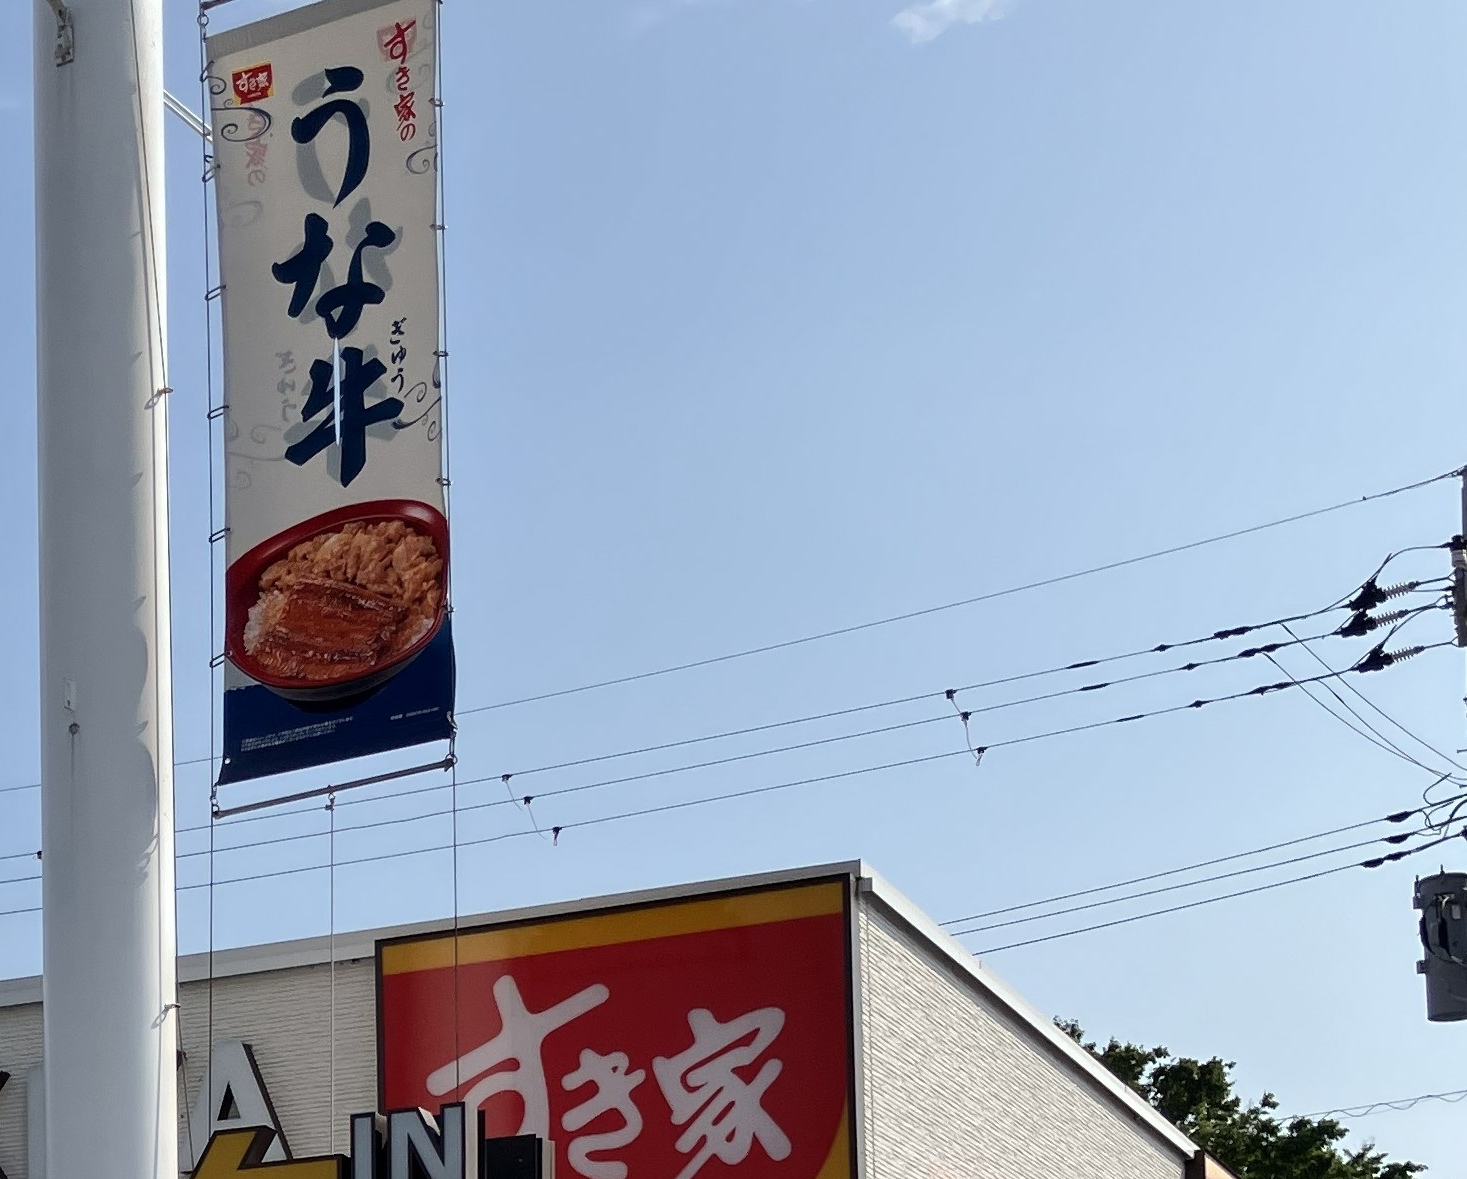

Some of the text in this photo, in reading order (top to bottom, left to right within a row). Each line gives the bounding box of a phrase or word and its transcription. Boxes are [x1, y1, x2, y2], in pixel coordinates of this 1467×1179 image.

[382, 19, 416, 142] すき家の
[271, 65, 405, 489] うな牛
